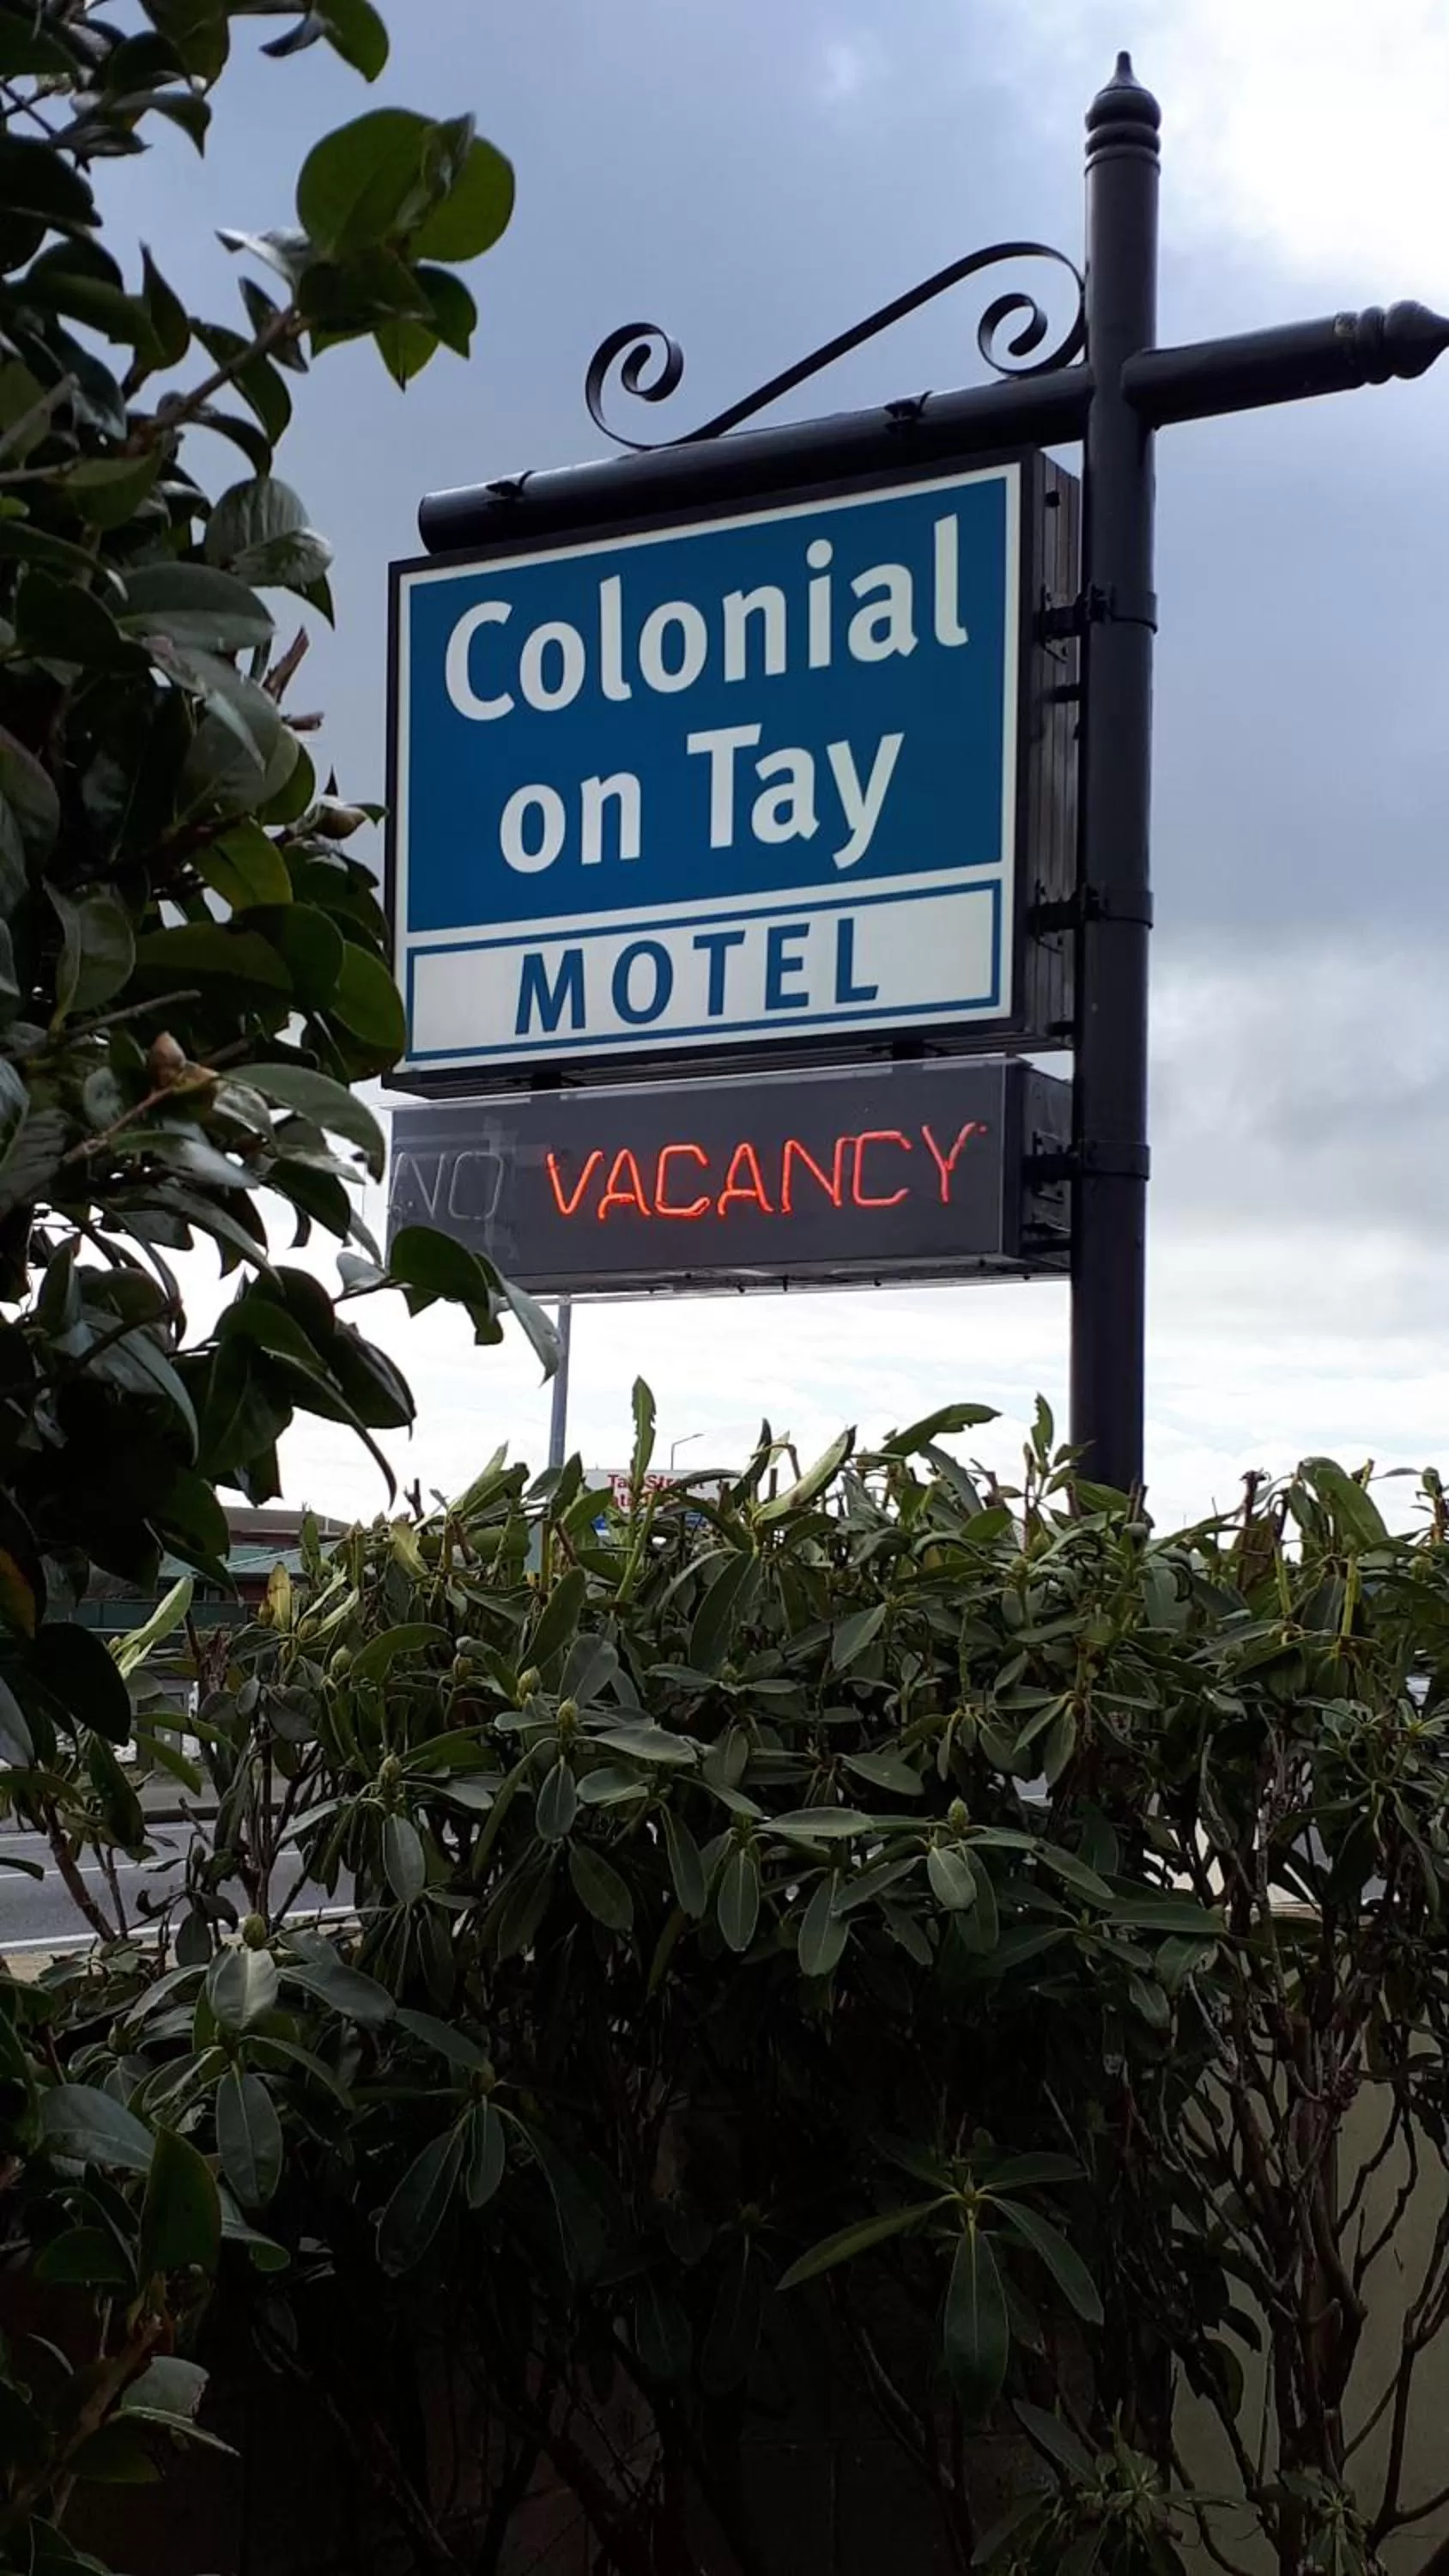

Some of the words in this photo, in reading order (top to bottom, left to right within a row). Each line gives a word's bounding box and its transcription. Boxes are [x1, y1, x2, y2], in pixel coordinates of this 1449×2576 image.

[444, 512, 970, 721] Colonial
[498, 769, 642, 874] on
[686, 721, 906, 871] Tay
[514, 915, 880, 1036] MOTEL
[389, 1151, 505, 1220] NO
[544, 1121, 985, 1220] VACANCY
